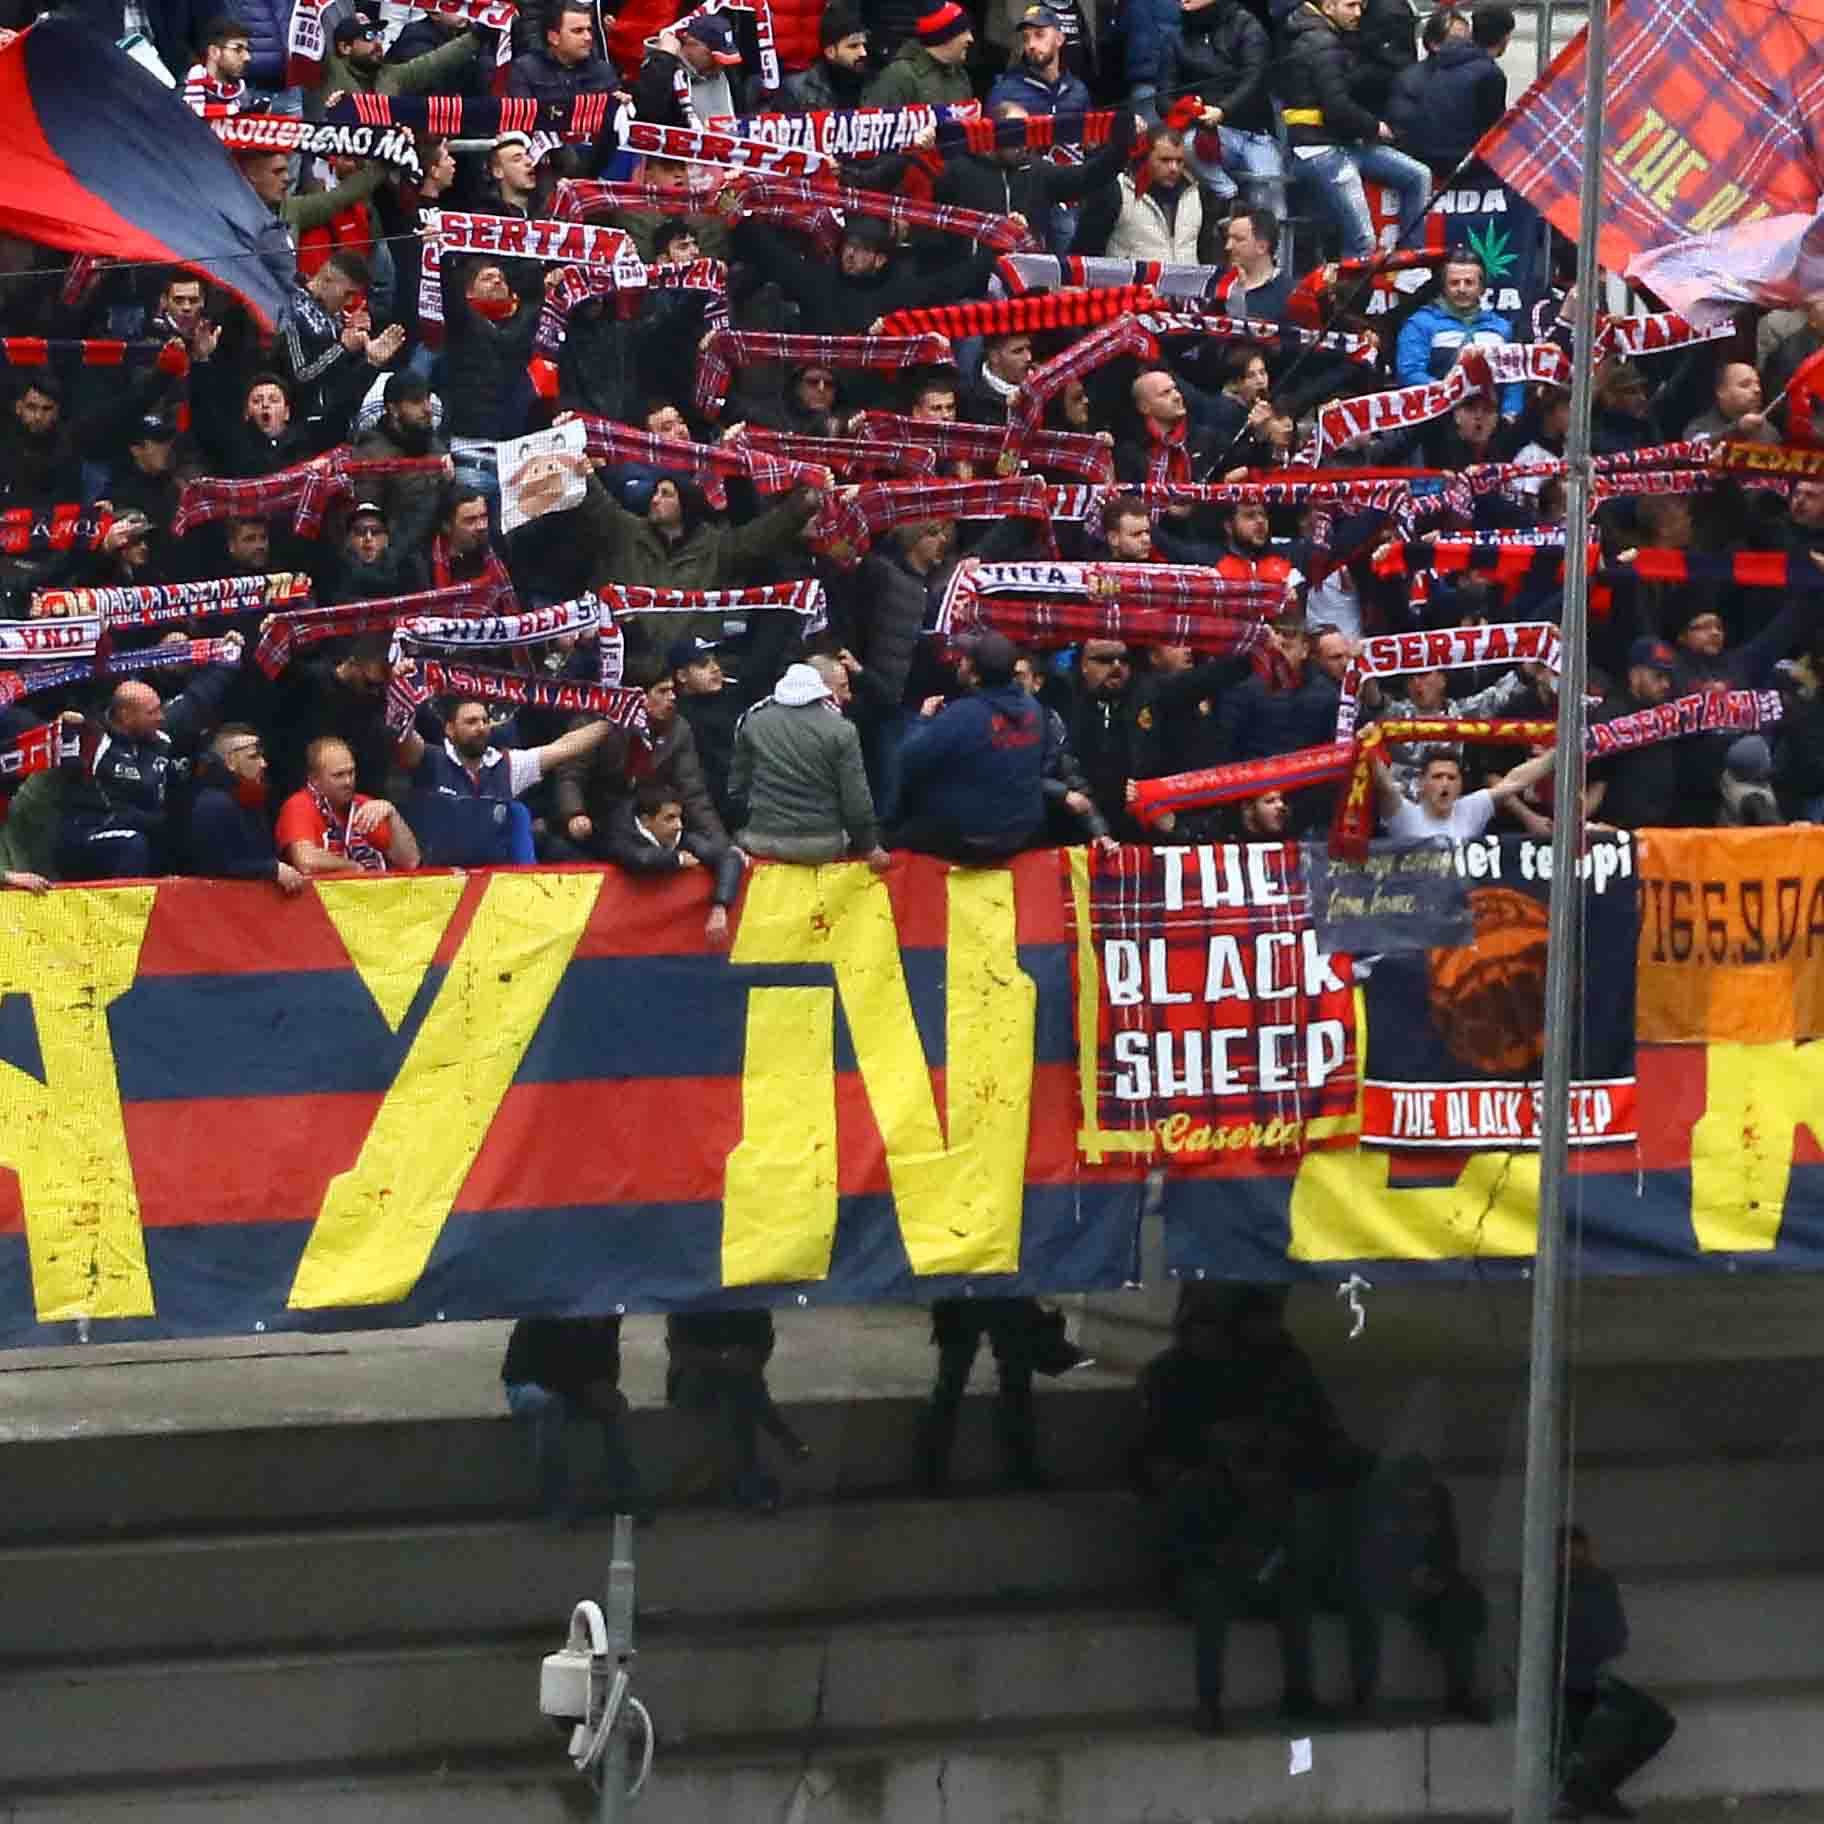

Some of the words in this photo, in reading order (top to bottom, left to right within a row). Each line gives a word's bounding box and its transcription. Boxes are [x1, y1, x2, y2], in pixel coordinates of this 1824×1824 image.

[1153, 842, 1290, 912] THE
[1520, 830, 1633, 895] tepi
[1103, 929, 1346, 1006] BLACK
[1113, 1019, 1345, 1102] SHEEP
[1155, 1112, 1304, 1156] Caserta
[1392, 1092, 1436, 1137] THE
[1446, 1093, 1523, 1138] BLACK
[1531, 1087, 1613, 1137] SEEP
